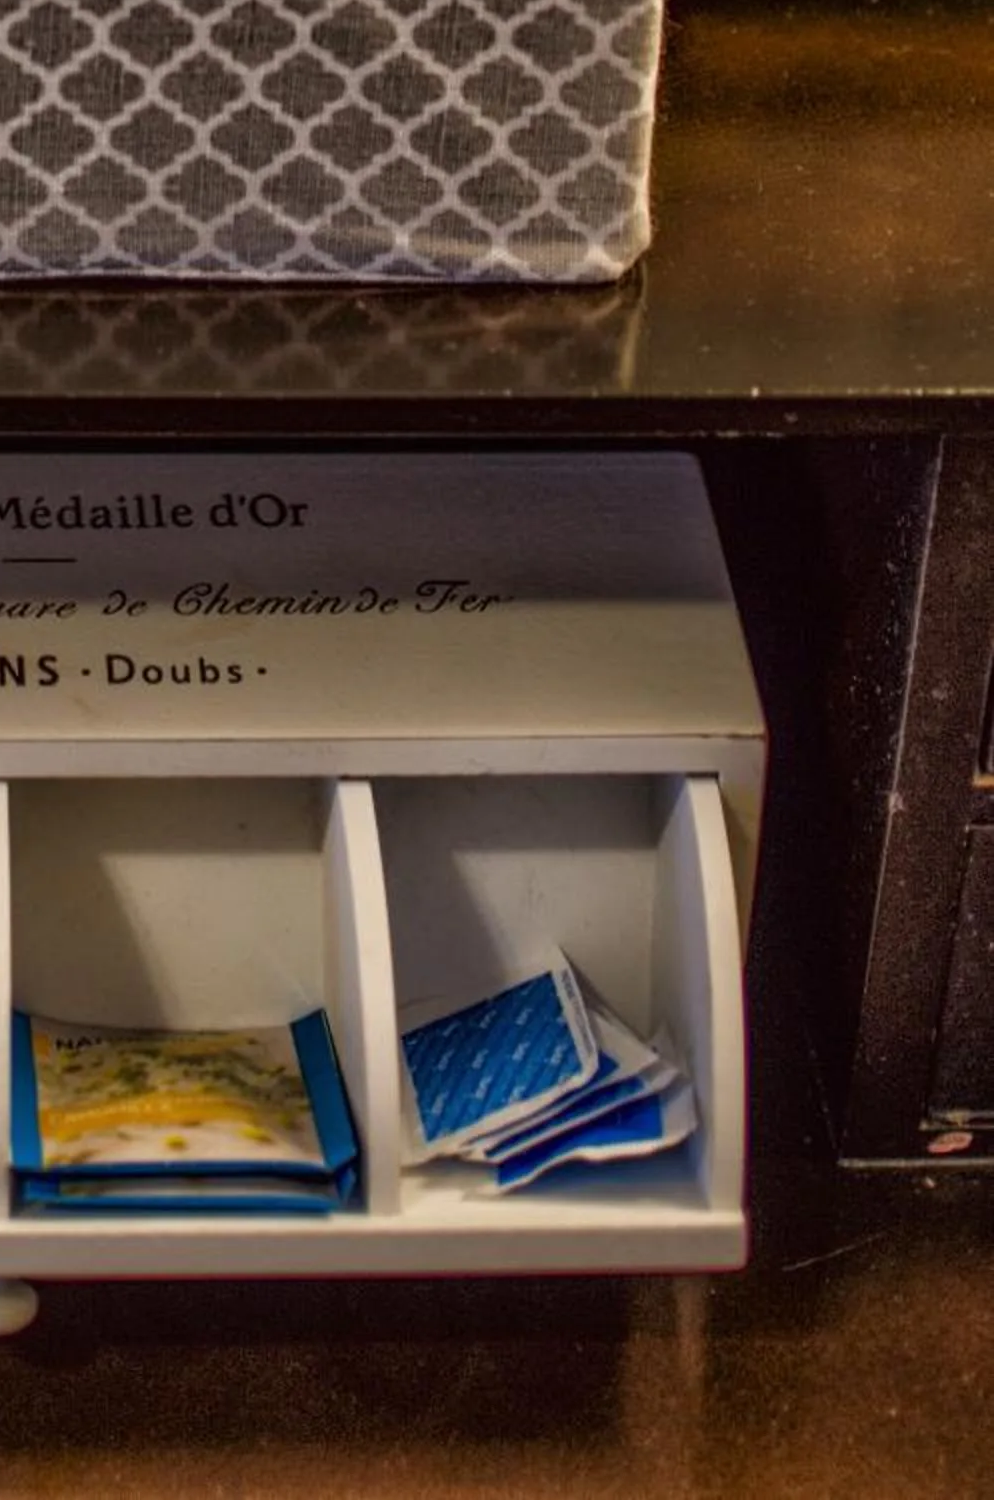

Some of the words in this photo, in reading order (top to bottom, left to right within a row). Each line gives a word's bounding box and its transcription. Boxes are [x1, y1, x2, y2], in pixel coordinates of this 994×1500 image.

[209, 492, 309, 529] d'Or
[102, 589, 148, 617] de
[172, 582, 351, 616] Chemin
[356, 587, 399, 615] de
[415, 579, 514, 614] Fer
